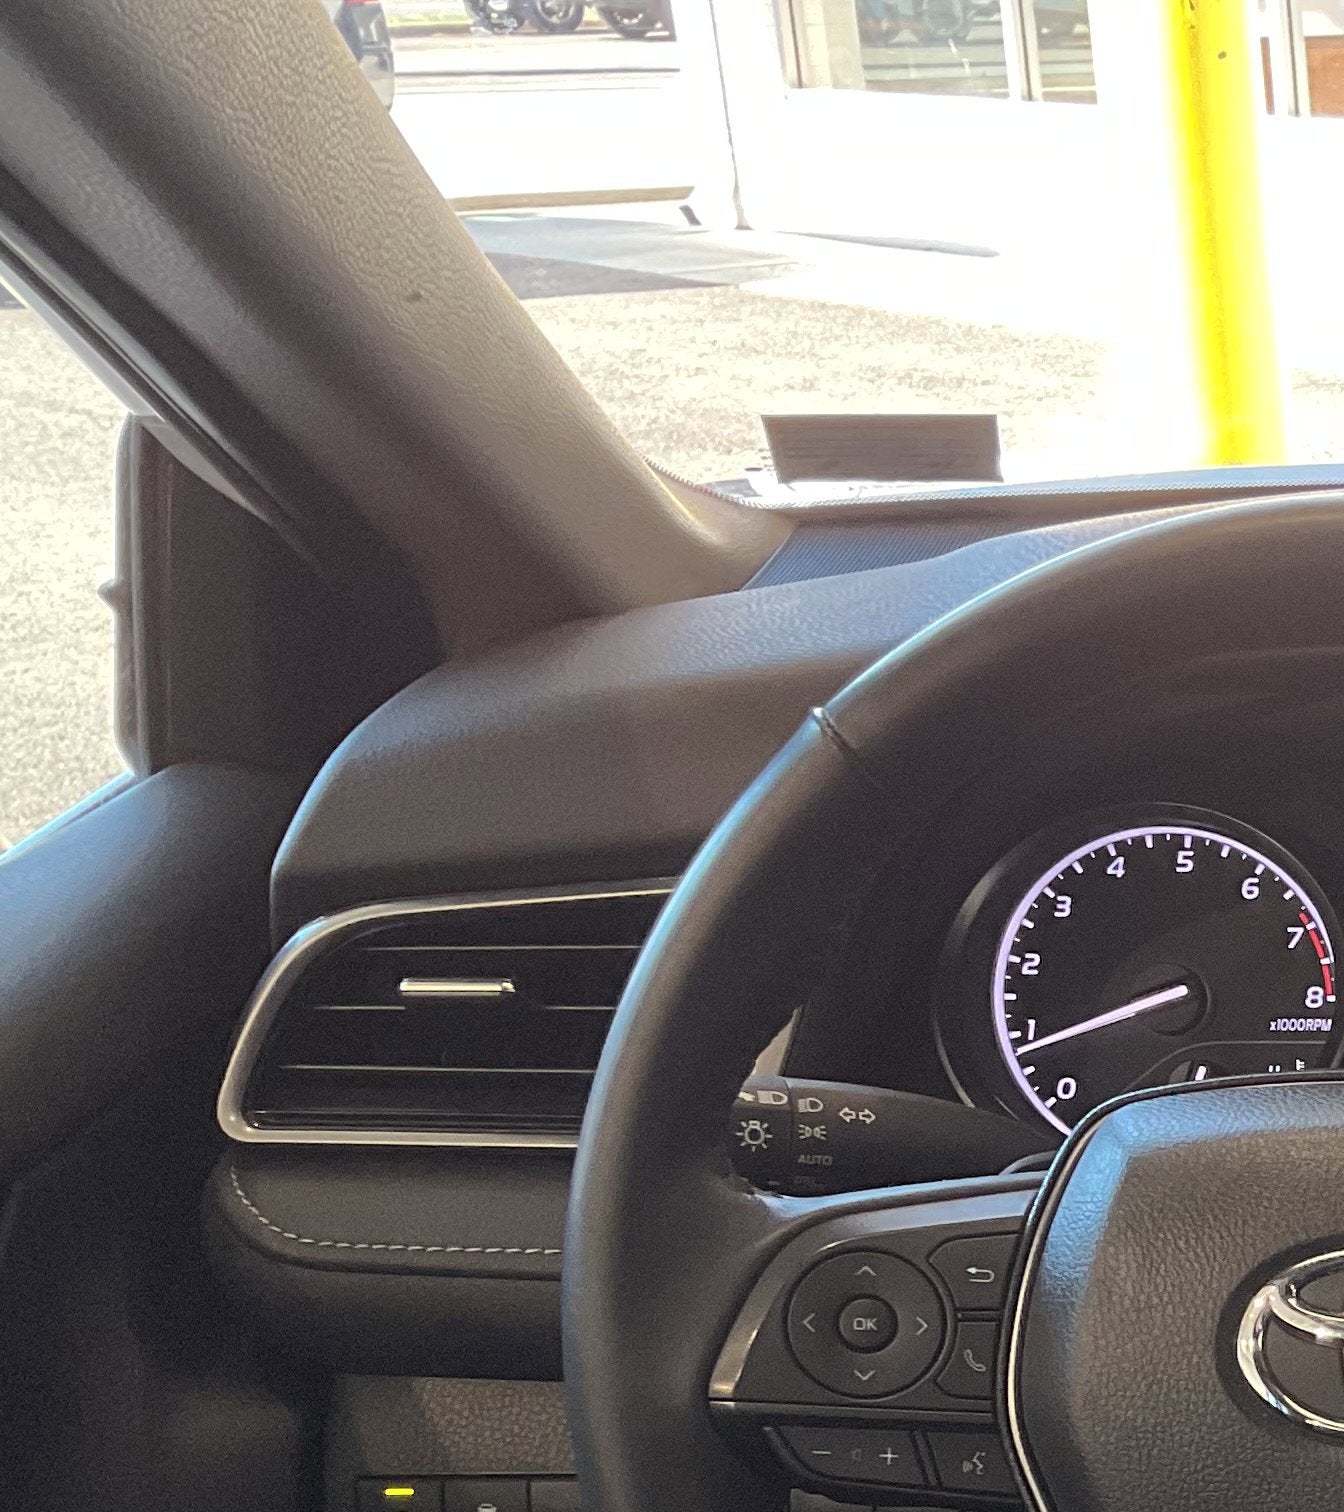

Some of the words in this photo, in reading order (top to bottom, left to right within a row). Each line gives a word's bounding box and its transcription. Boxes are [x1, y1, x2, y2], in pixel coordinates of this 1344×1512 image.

[1106, 856, 1126, 878] 4
[1175, 850, 1194, 873] 5
[1241, 877, 1260, 900] 6
[1053, 895, 1072, 918] 3
[1286, 926, 1305, 948] 7
[1021, 953, 1041, 975] 2
[1304, 986, 1324, 1009] 8
[1027, 1018, 1037, 1041] 1
[1269, 1018, 1333, 1032] x1000RPM
[1056, 1077, 1077, 1100] 0
[797, 1154, 834, 1166] AUTO
[853, 1317, 878, 1331] OK
